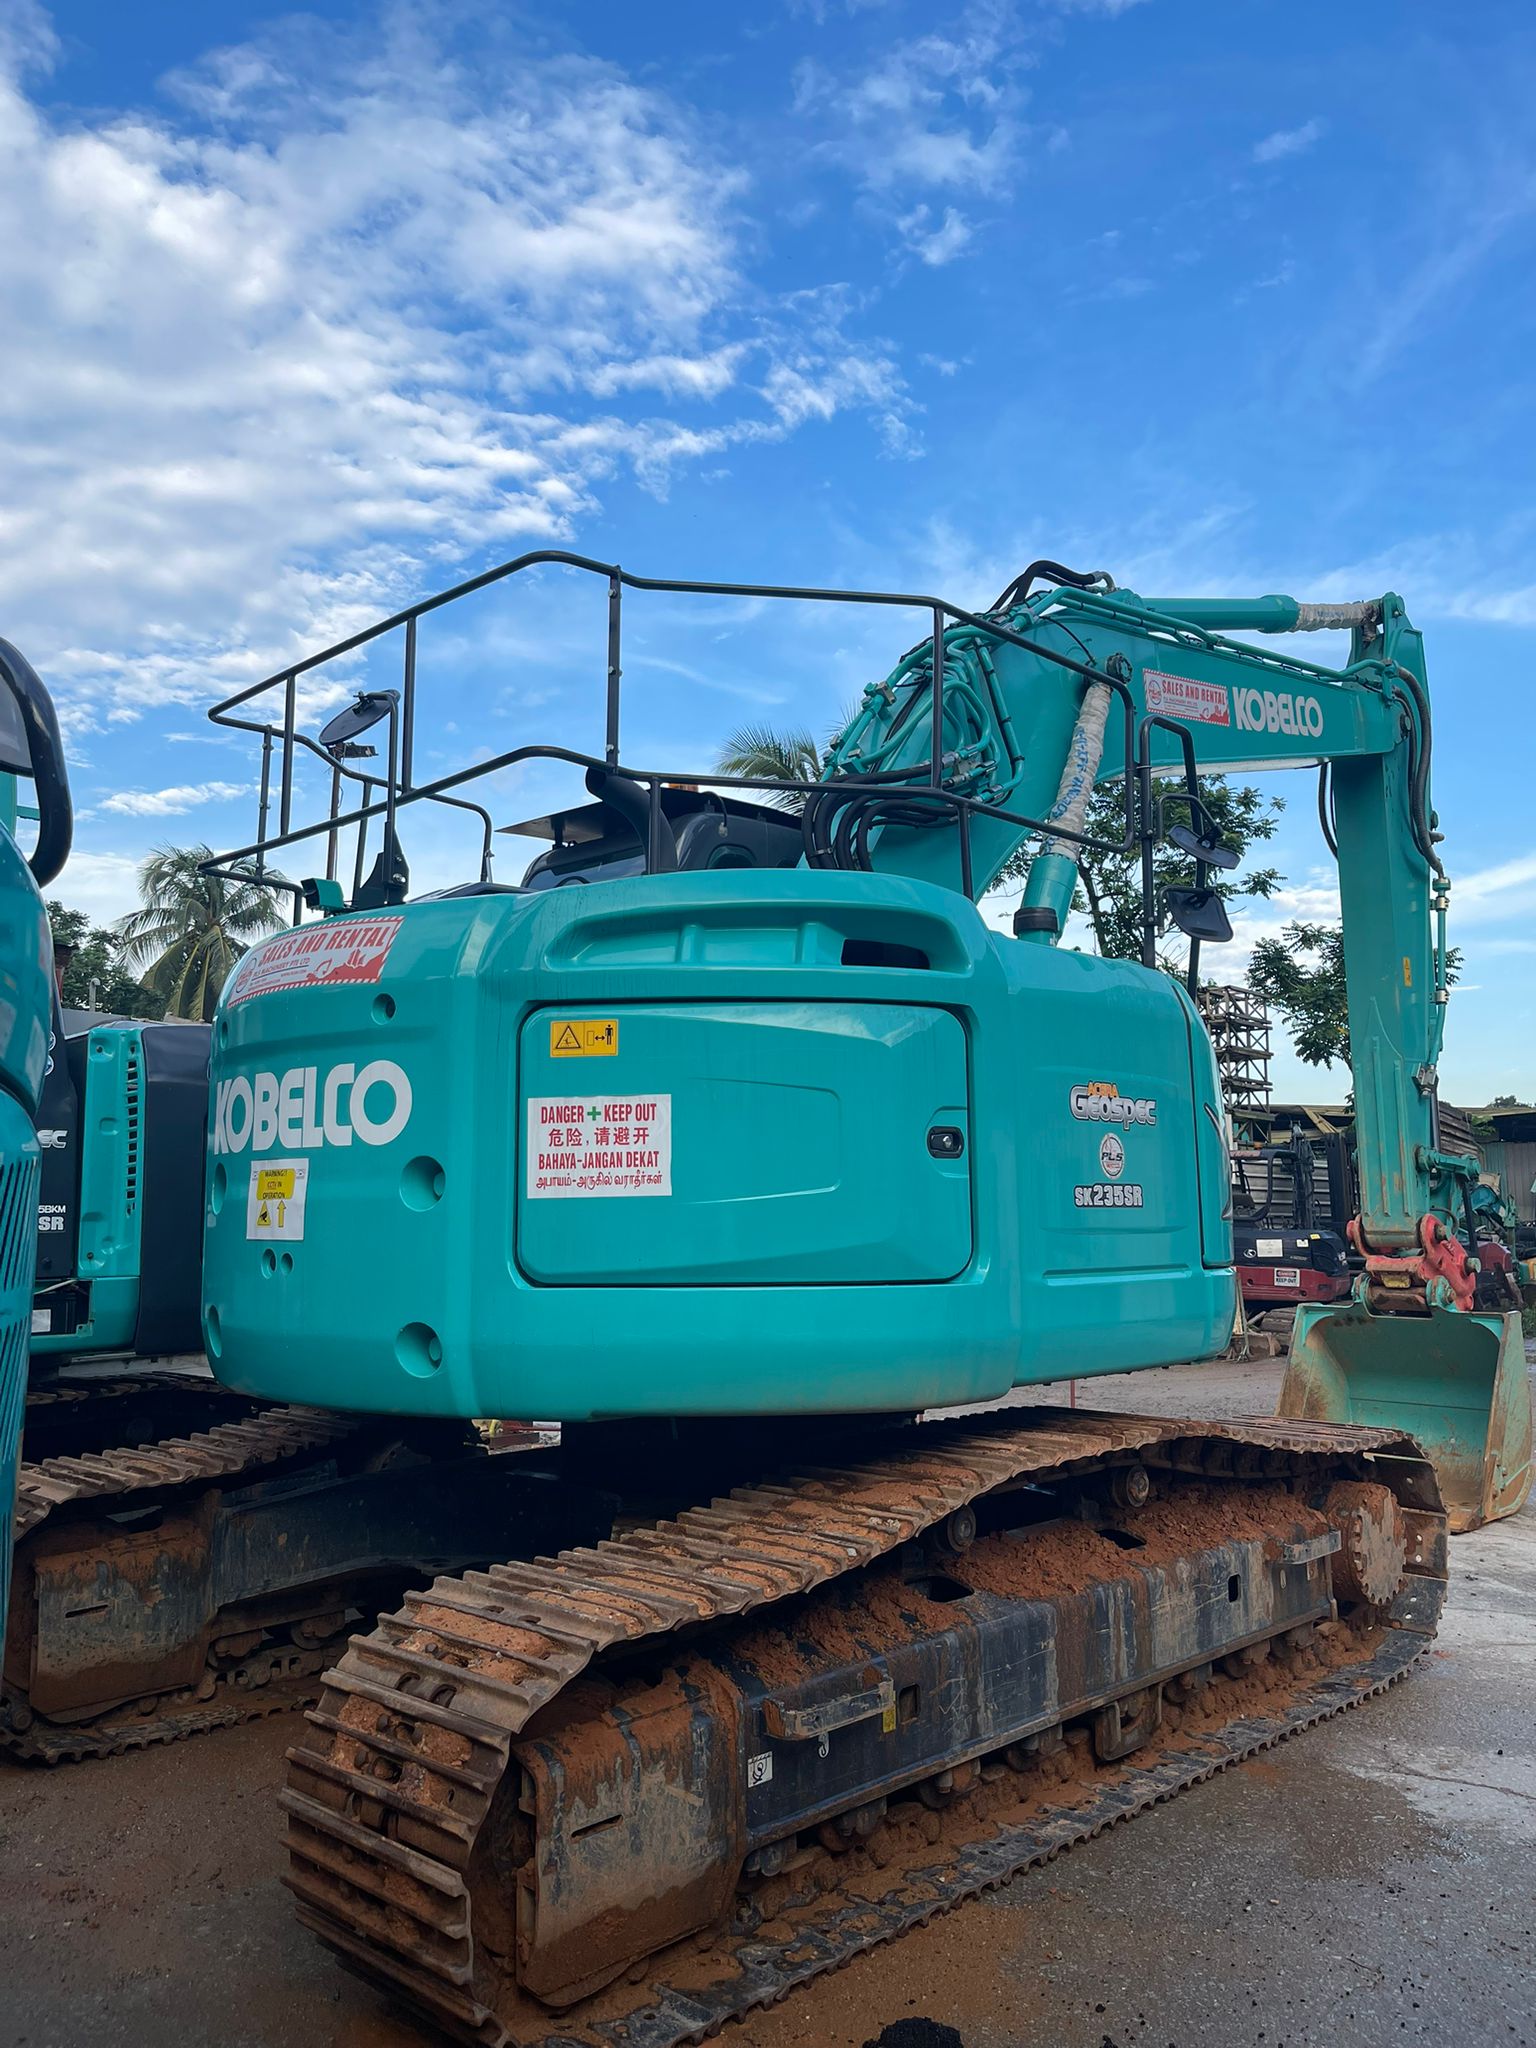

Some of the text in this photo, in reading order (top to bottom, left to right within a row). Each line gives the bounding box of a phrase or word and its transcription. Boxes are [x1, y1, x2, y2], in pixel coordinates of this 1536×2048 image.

[1162, 680, 1184, 697] SALES
[1186, 685, 1200, 700] AND
[1201, 688, 1226, 705] RENTAL
[1232, 686, 1323, 738] KOBELCO
[258, 926, 391, 967] SALES AND RENTAL
[214, 1060, 413, 1155] KOBELCO
[541, 1103, 657, 1124] DANGER KEEP OUT
[538, 1151, 659, 1170] BAHAYA-JANGAN DEKAT
[1075, 1184, 1143, 1207] SK235SR
